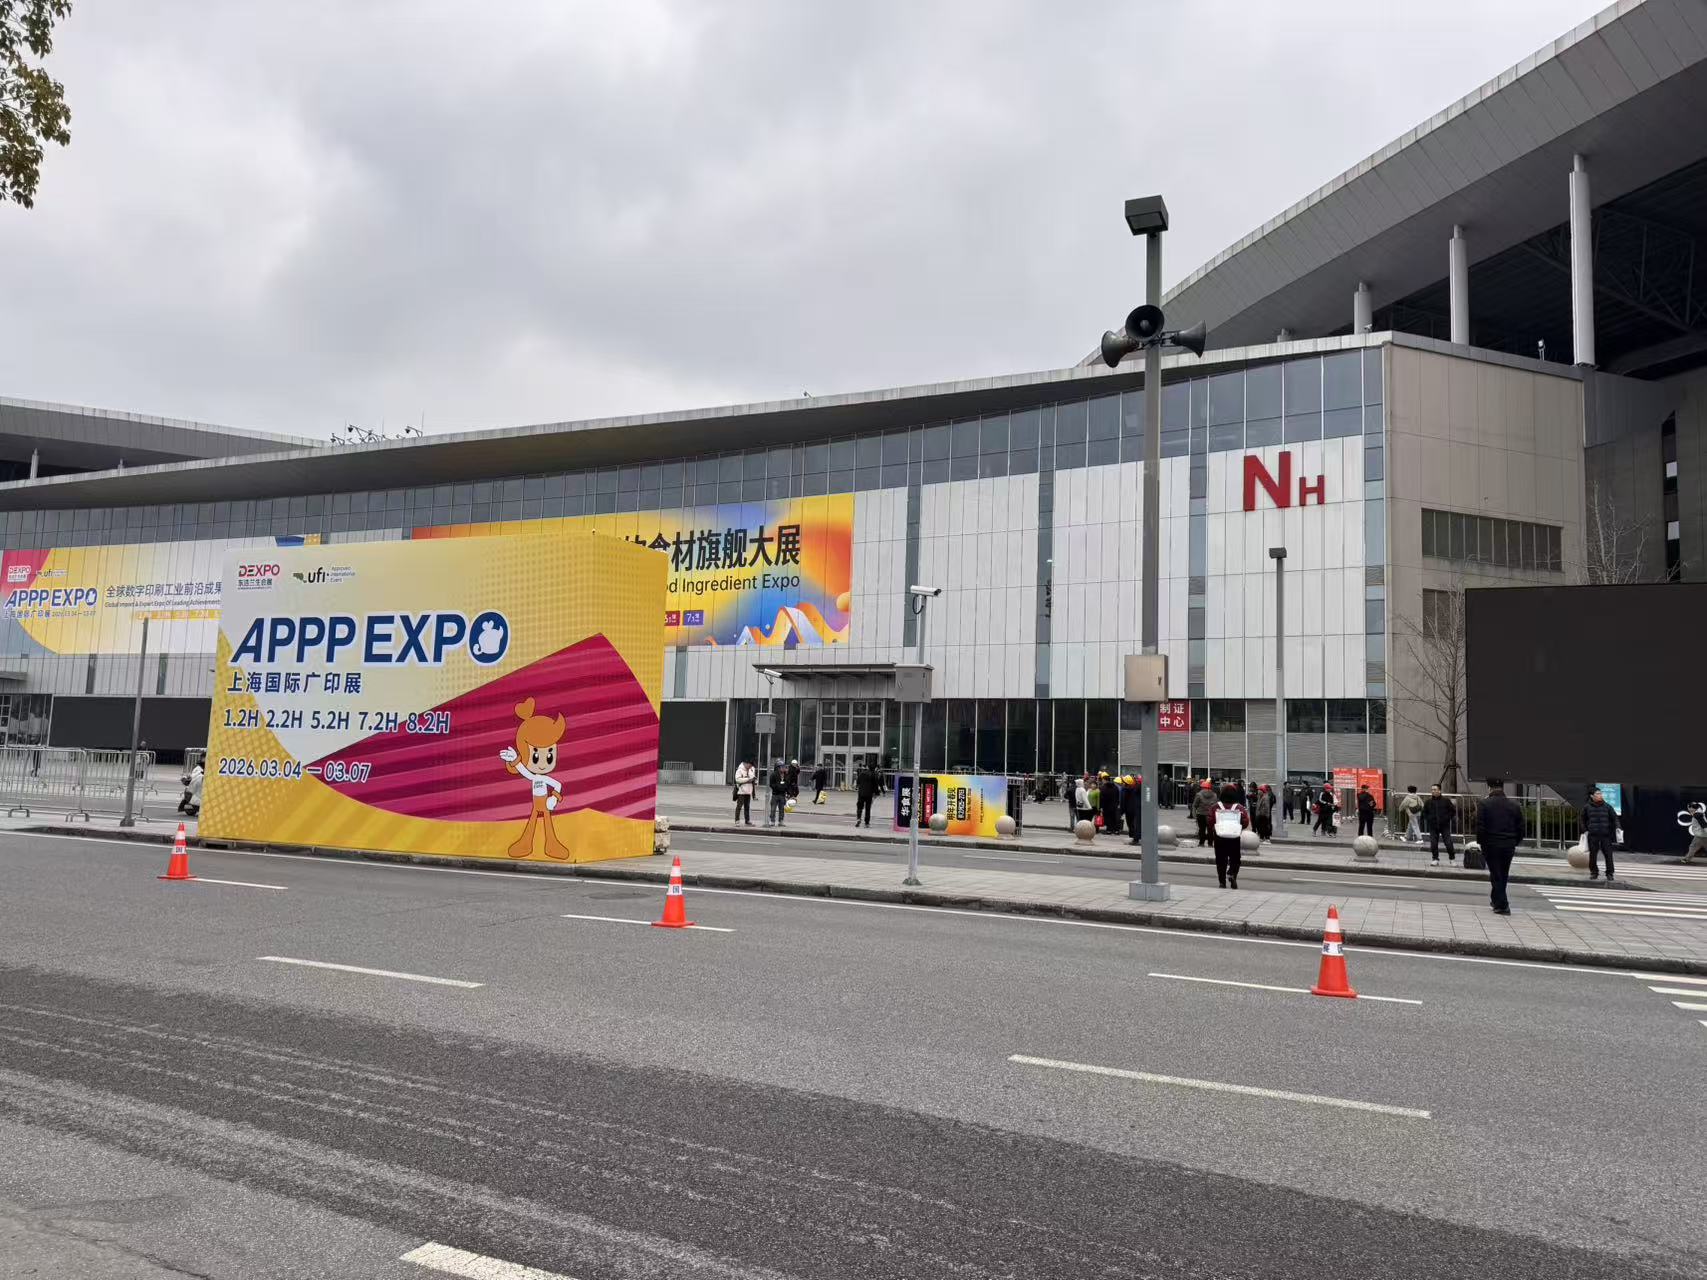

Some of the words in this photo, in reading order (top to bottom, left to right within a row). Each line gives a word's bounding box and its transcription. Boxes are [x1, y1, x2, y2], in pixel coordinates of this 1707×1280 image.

[625, 525, 800, 573] 材旗舰大展
[239, 564, 280, 577] DEXPO
[308, 567, 326, 583] ufi
[682, 575, 757, 596] Ingredient
[762, 573, 800, 592] Expo
[5, 589, 49, 608] APPP
[51, 587, 98, 606] EXPO
[230, 616, 356, 663] APPP
[363, 611, 509, 664] EXPO
[227, 672, 361, 694] 上海国际广印展
[1160, 703, 1184, 714] 制证
[224, 709, 258, 728] 1.2H
[266, 710, 303, 729] 2.2H
[311, 711, 349, 730] 5.2H
[359, 712, 398, 732] 7.2H
[406, 712, 450, 733] 8.2H
[1160, 716, 1184, 727] 中心
[947, 787, 956, 820] 明年开春见
